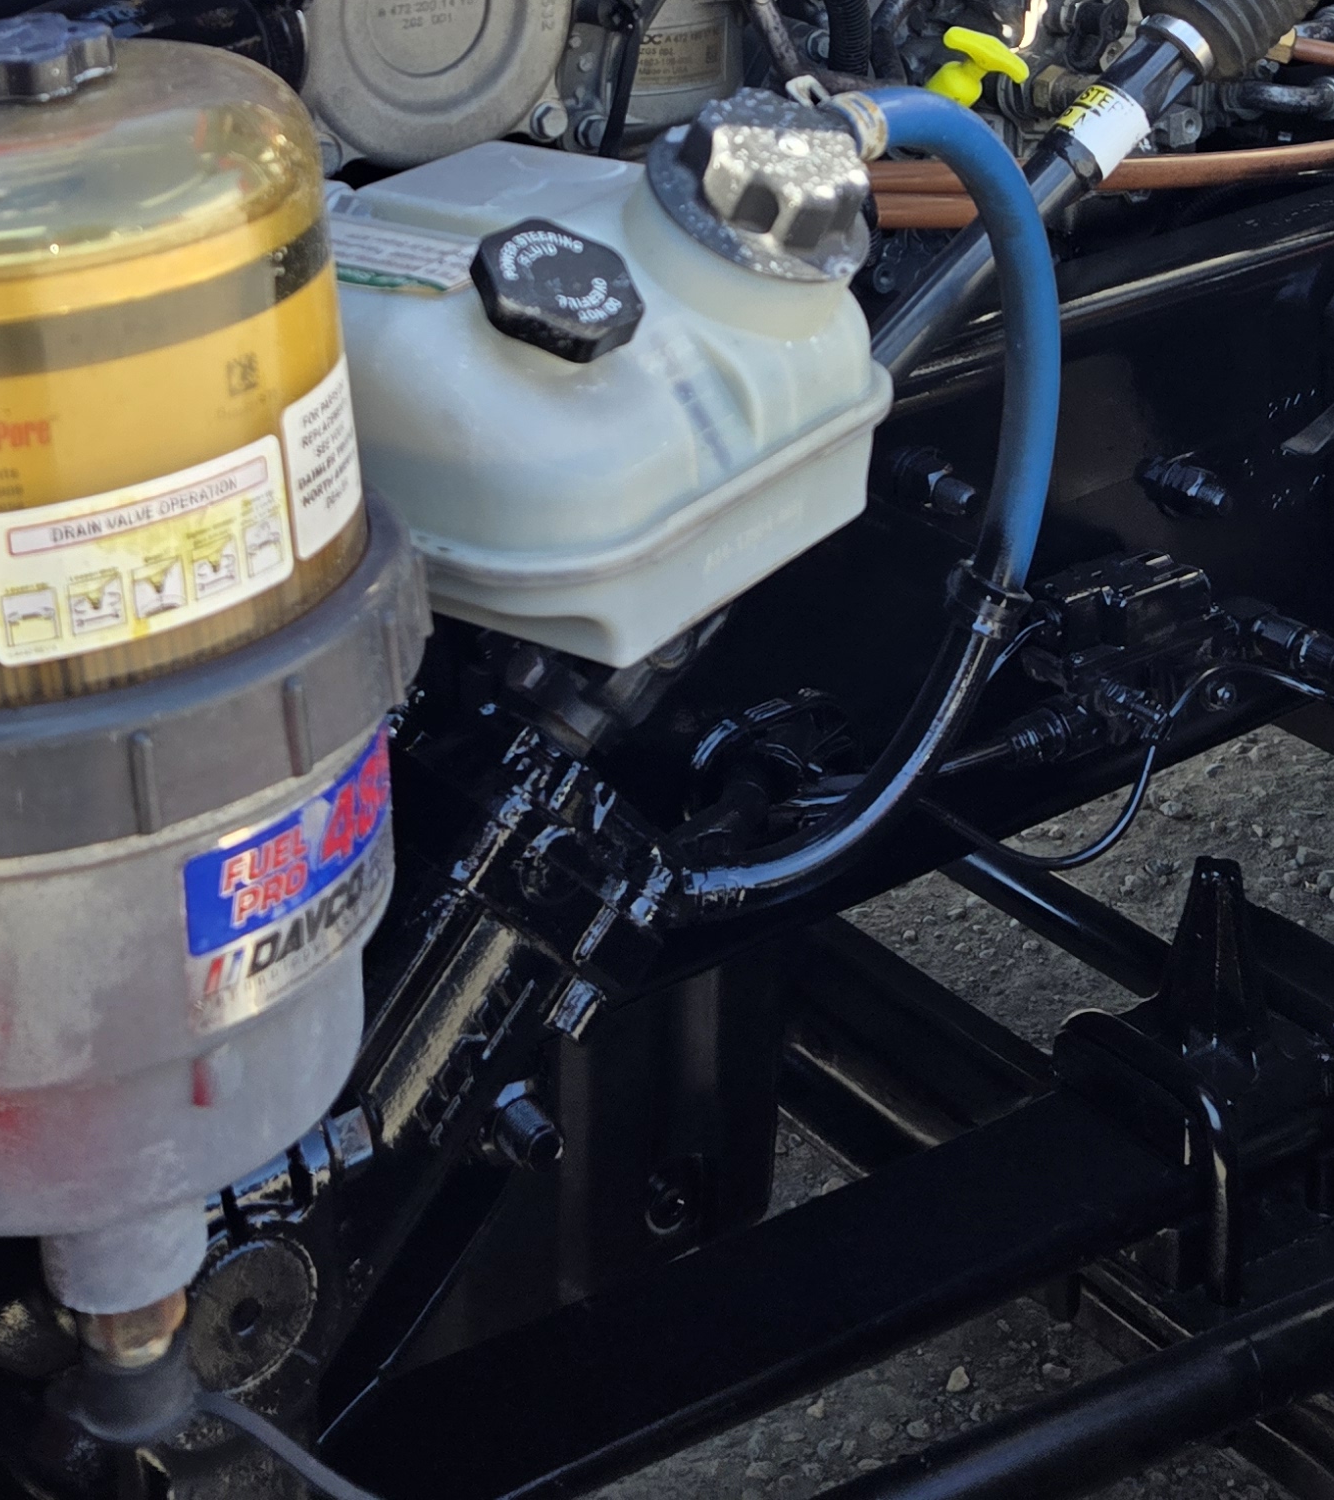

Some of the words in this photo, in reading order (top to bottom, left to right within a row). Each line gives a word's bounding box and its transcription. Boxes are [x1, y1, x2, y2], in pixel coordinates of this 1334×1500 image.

[499, 240, 520, 281] POWER
[511, 230, 584, 254] STEERING
[516, 242, 558, 269] FLUID
[51, 518, 104, 543] DRAIN
[105, 507, 155, 532] VALVE
[157, 475, 239, 516] OPERATION
[220, 822, 309, 897] FUEL
[230, 857, 310, 929] PRO
[246, 861, 366, 979] DAVCO
